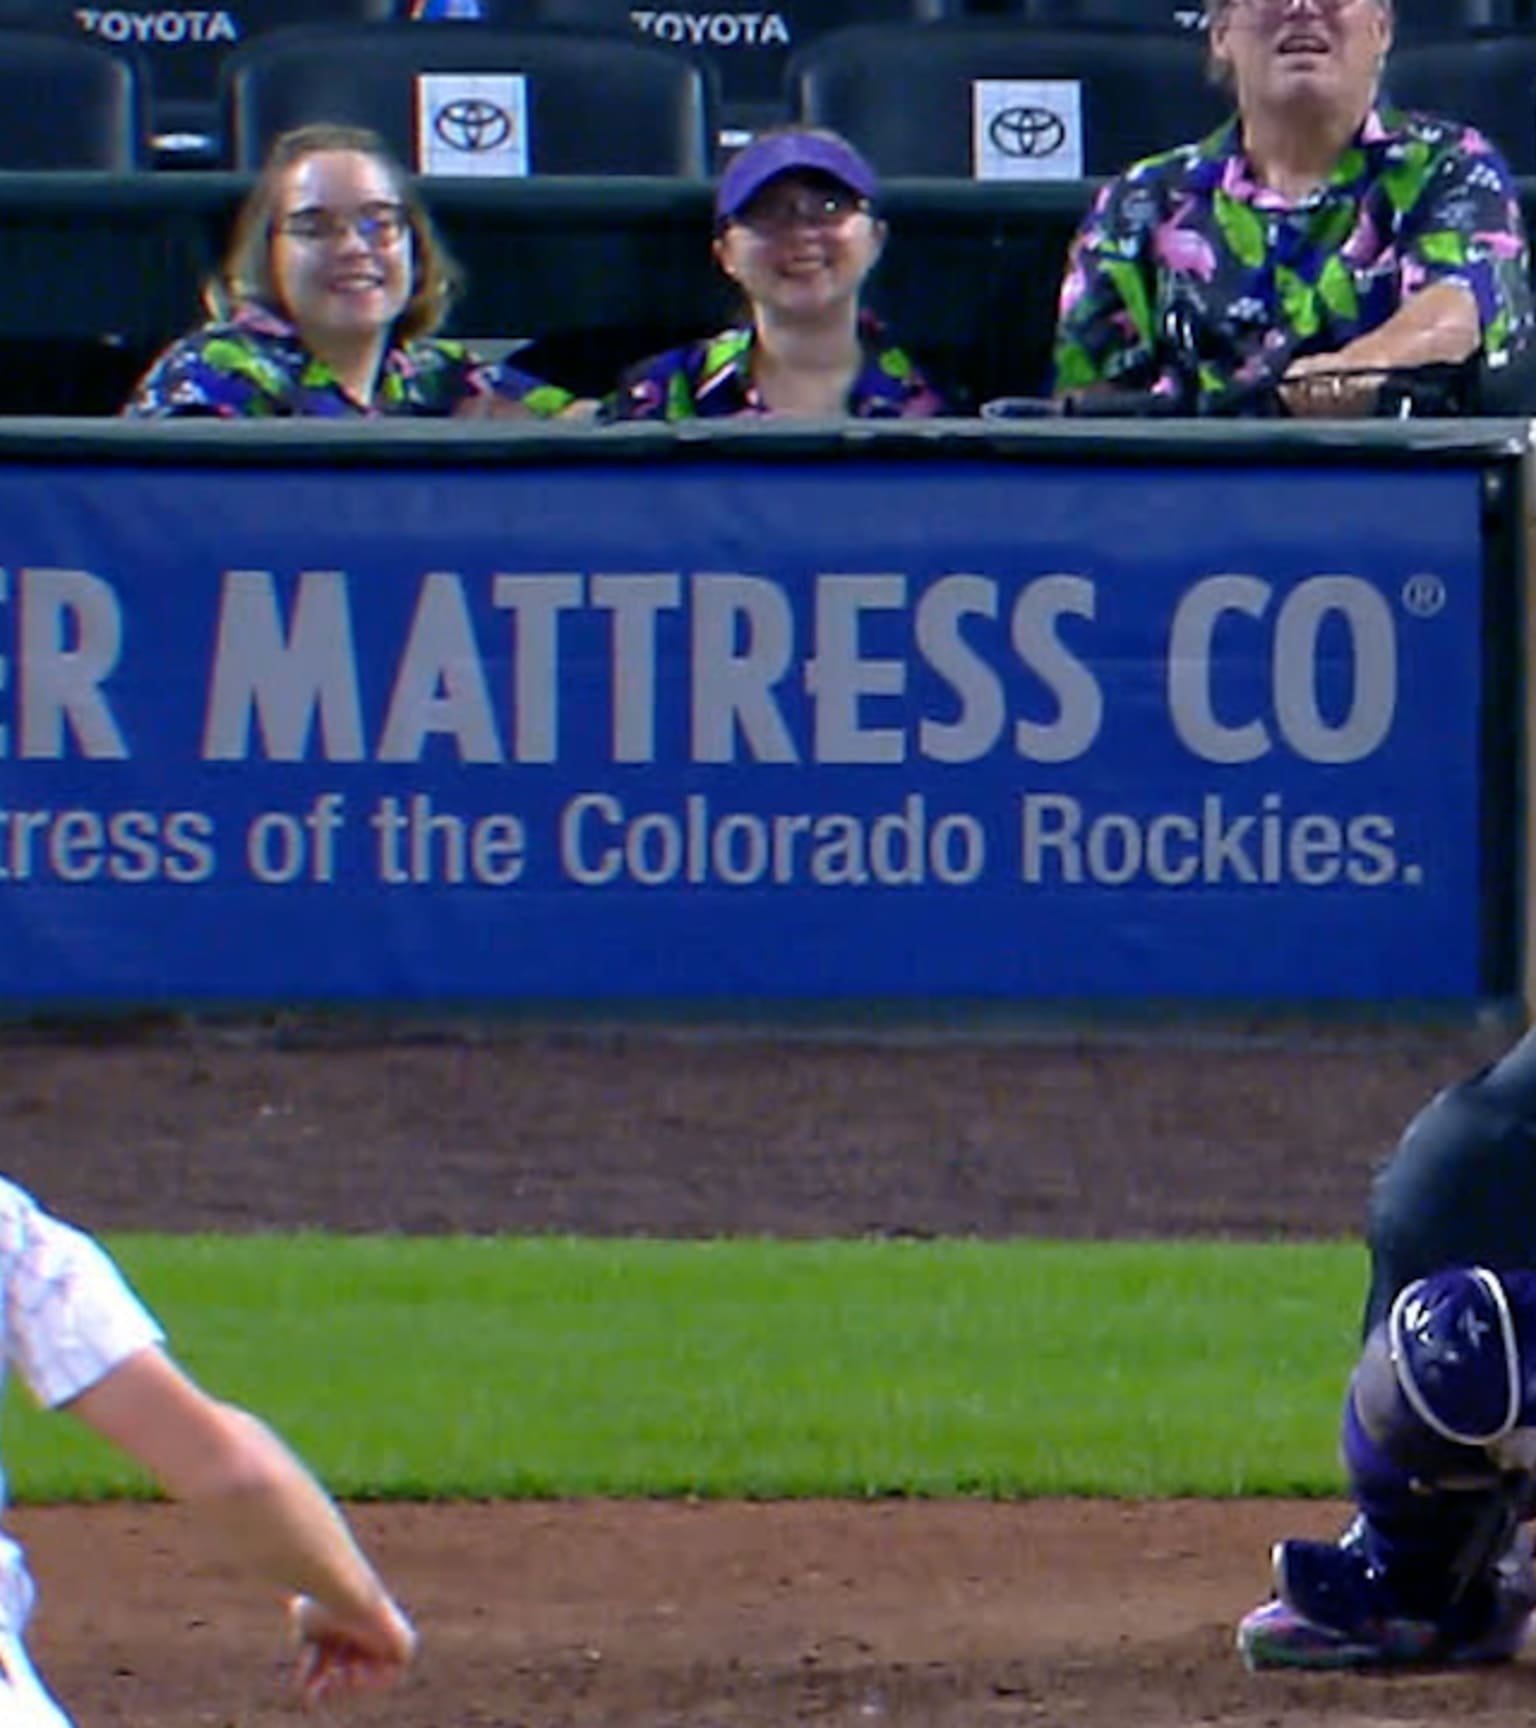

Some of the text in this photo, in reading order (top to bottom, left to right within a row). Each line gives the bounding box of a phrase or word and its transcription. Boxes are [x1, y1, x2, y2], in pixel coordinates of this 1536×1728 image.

[75, 9, 237, 42] TOYOTA
[630, 10, 790, 44] TOYOTA
[0, 566, 130, 760] R
[203, 569, 1103, 764] MATTRESS
[247, 794, 344, 882] of
[372, 795, 524, 884] the
[560, 794, 985, 885] Colorado
[1022, 794, 1424, 885] Rockies.
